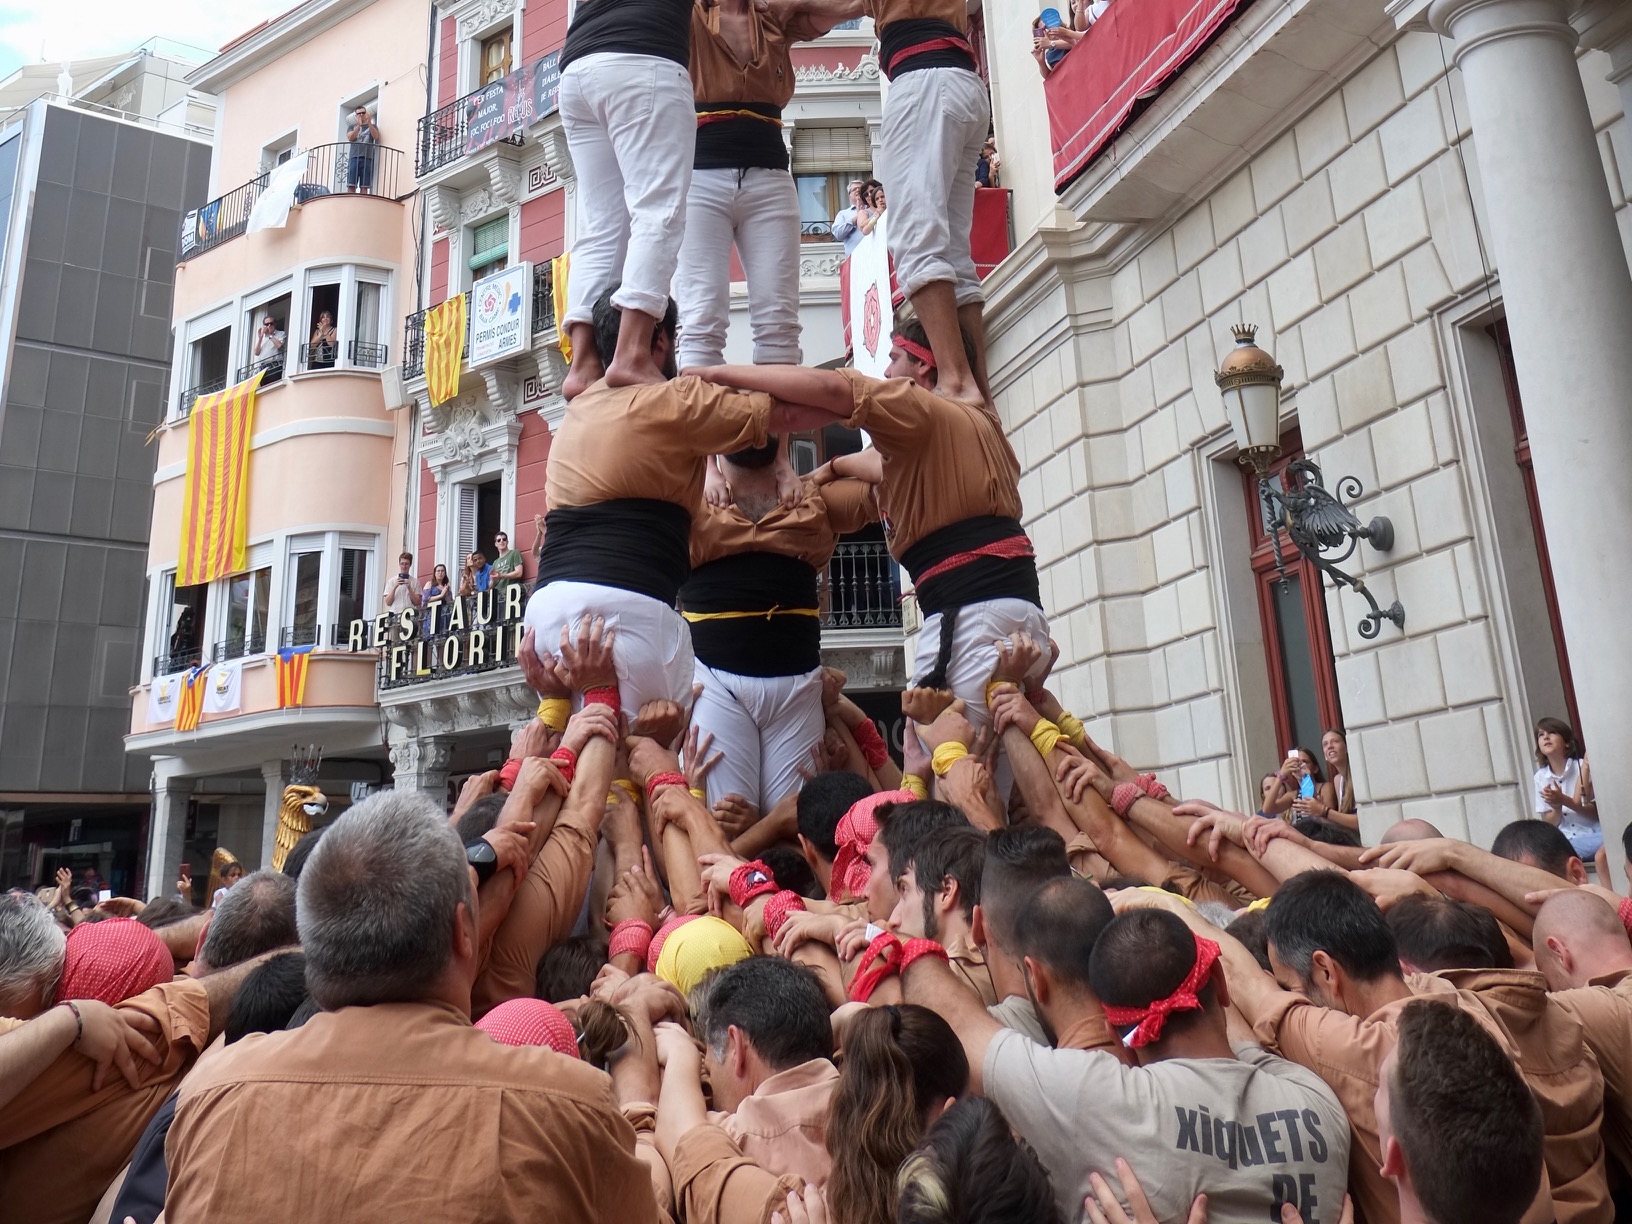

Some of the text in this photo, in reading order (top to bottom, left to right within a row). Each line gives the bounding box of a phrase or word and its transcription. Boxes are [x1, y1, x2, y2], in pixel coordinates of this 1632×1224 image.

[486, 86, 504, 100] FESTA
[496, 318, 519, 336] CONDUIR
[498, 333, 517, 349] ARMES
[1270, 1173, 1319, 1224] DE
